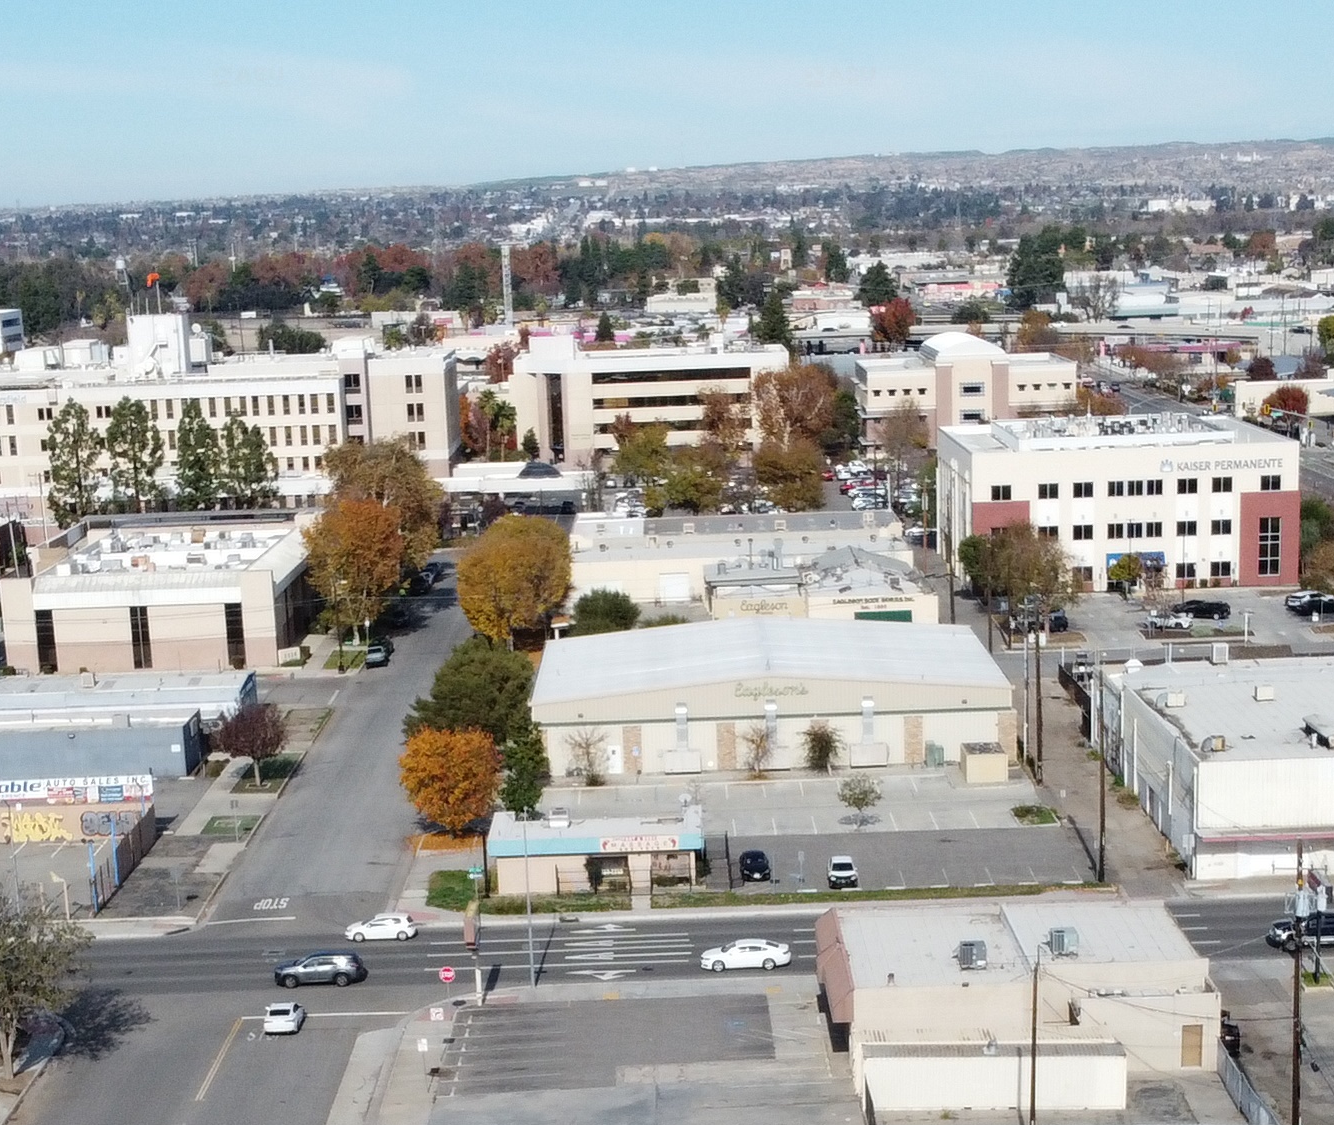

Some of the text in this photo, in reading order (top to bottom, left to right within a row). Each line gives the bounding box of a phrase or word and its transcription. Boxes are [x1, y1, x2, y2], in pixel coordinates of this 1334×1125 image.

[1177, 458, 1283, 472] KAISER PERMANENTE
[740, 600, 788, 613] Eagleson
[47, 779, 75, 787] AUTO
[83, 777, 119, 786] SALES
[253, 898, 289, 910] STOP
